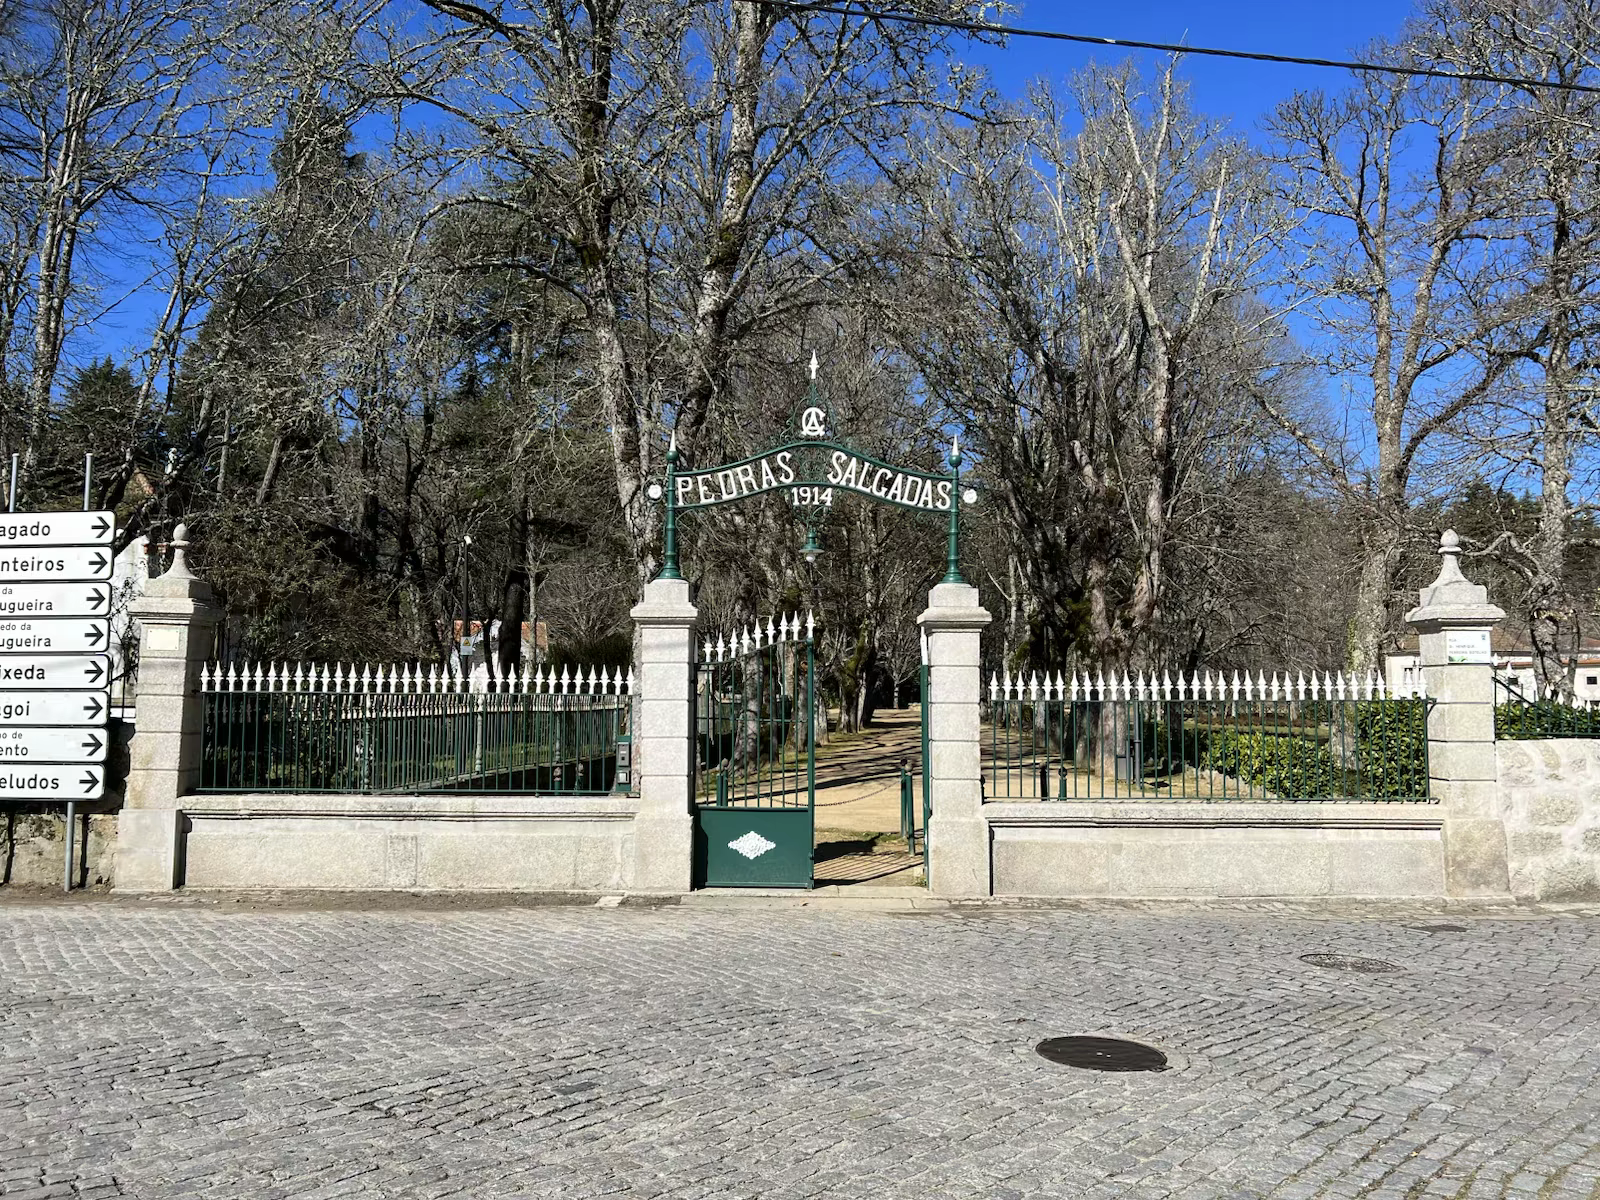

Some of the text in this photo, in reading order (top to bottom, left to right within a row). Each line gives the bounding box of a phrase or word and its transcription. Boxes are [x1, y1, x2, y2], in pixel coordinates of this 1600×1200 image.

[675, 451, 952, 510] PEDRAS SALGADAS
[791, 486, 833, 506] 1914
[1, 586, 13, 595] da
[20, 622, 32, 631] da
[11, 730, 23, 739] de
